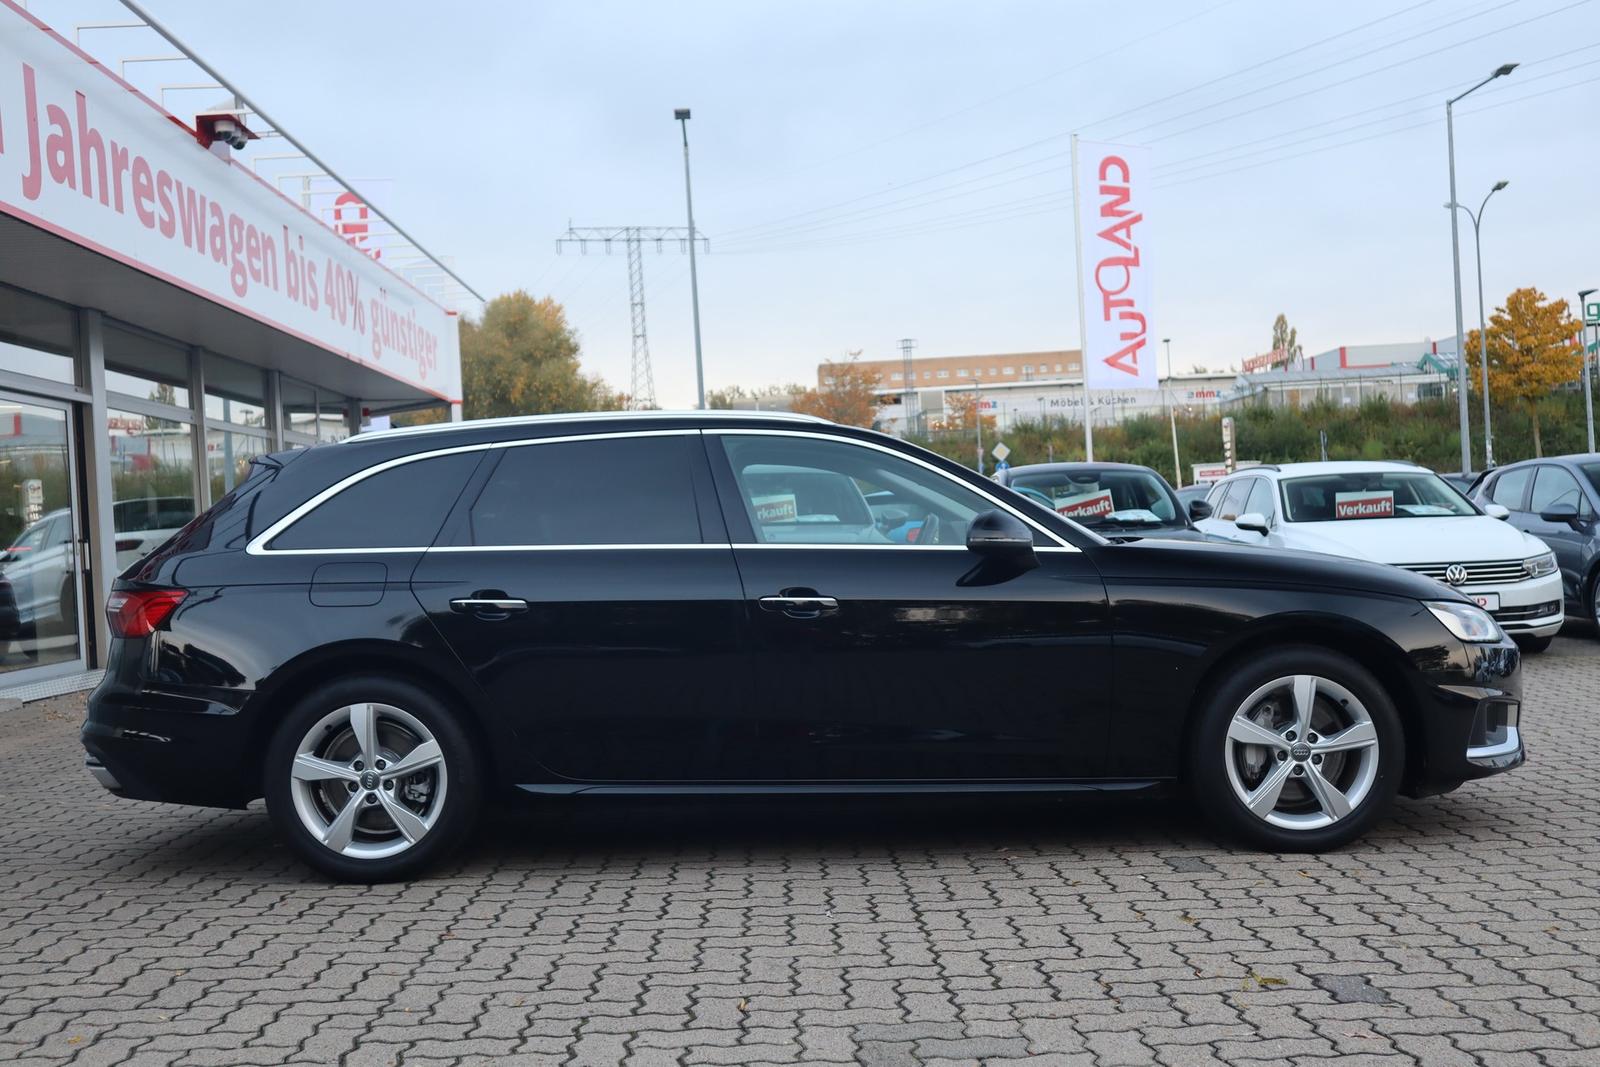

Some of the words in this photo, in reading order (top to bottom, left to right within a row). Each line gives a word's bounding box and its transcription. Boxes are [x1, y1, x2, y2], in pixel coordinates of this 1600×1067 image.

[22, 62, 279, 298] Jahreswagen
[283, 224, 320, 312] bis
[324, 257, 366, 335] 40%
[370, 287, 438, 381] günstiger
[1095, 155, 1147, 377] AUTOLAND
[1050, 397, 1084, 408] Möbel
[757, 503, 794, 521] rkauft
[1338, 500, 1392, 516] Verkauft
